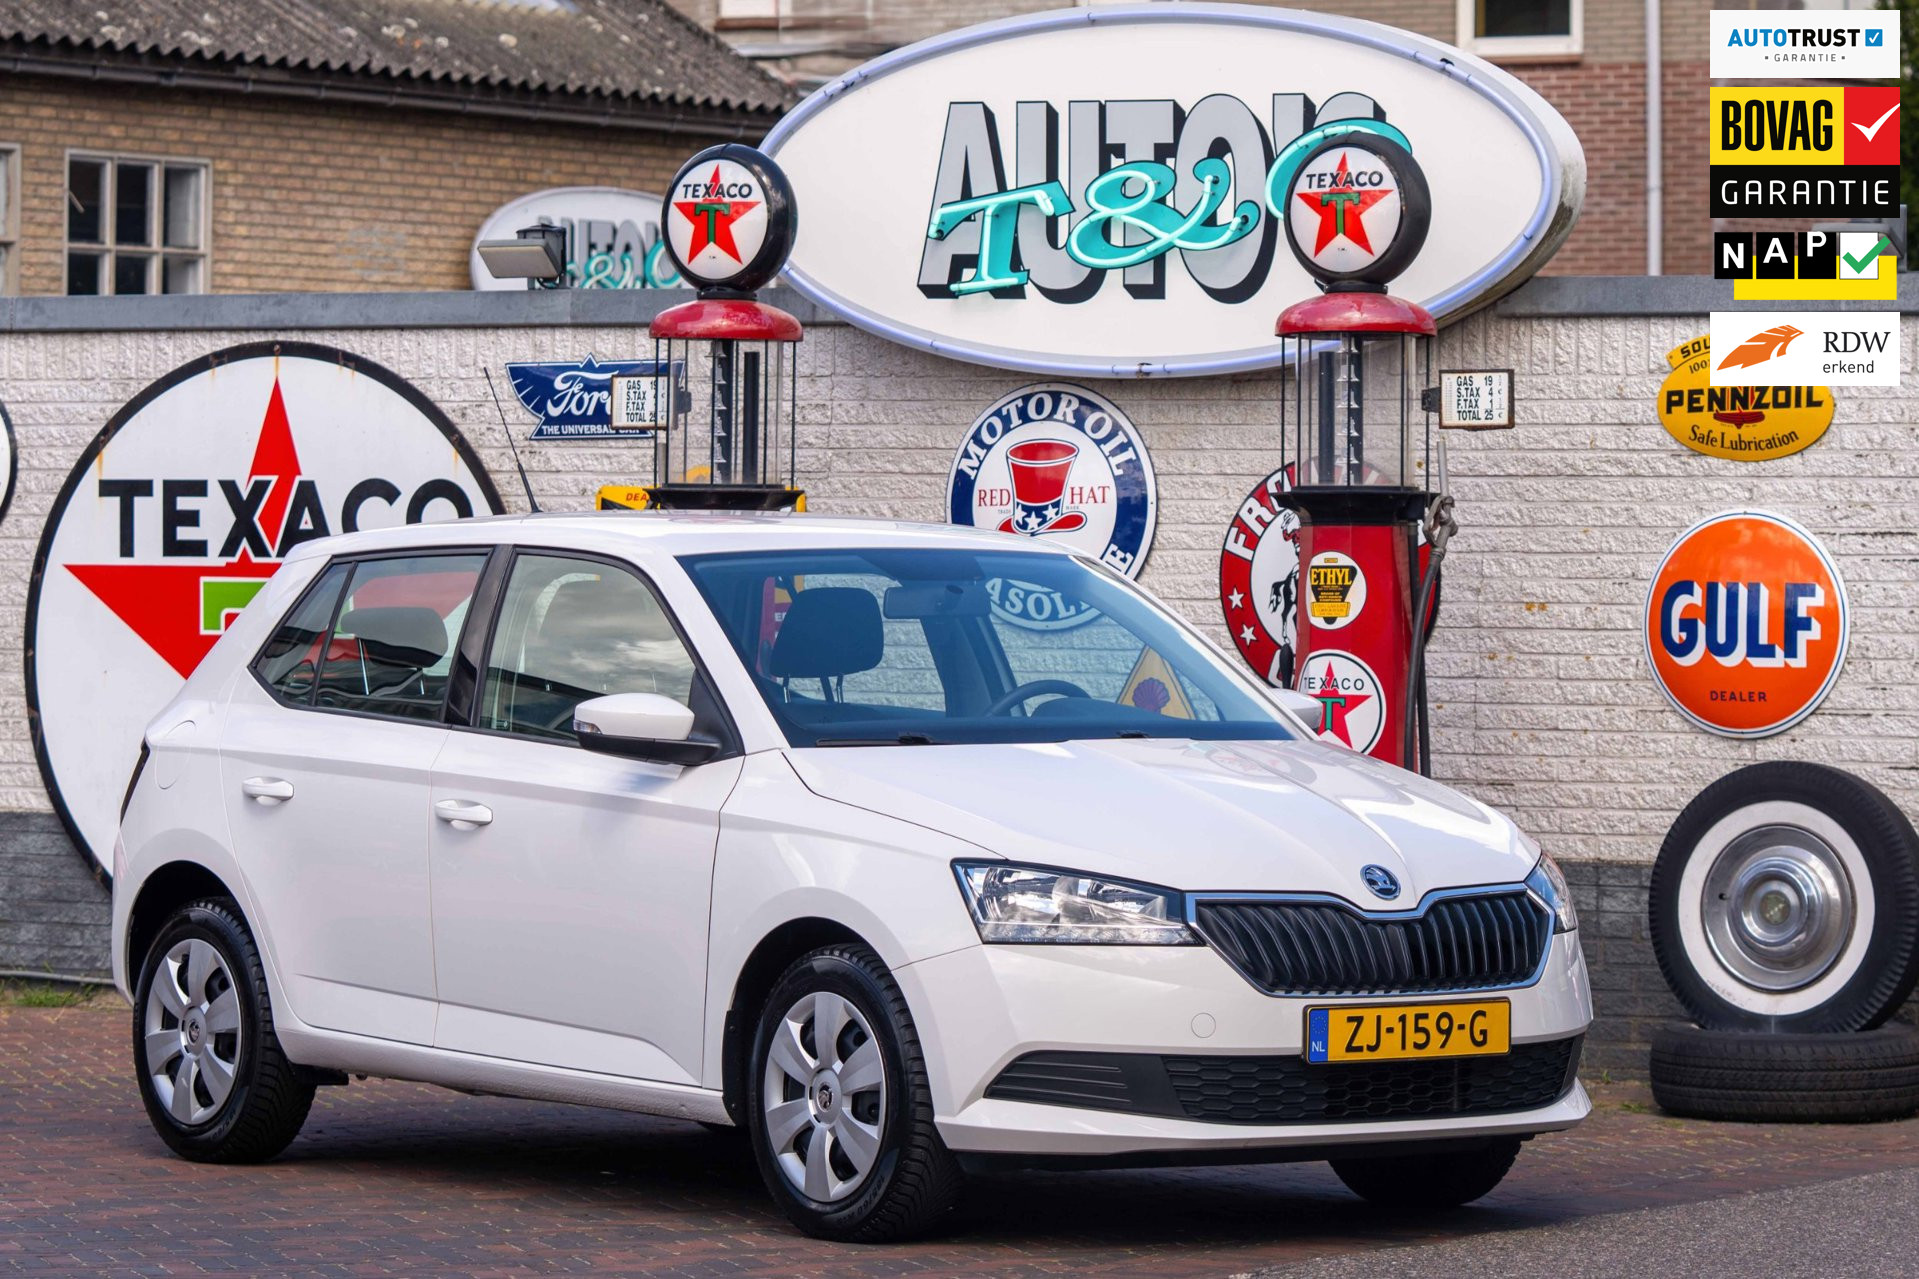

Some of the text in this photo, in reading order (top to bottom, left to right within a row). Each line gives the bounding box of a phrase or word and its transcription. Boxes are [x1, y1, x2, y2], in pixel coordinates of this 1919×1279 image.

[1306, 170, 1384, 189] TEXACO
[682, 183, 753, 199] TEXACO
[1321, 191, 1361, 236] T
[694, 203, 730, 243] T
[626, 380, 642, 391] GAS
[1456, 375, 1493, 387] GAS 19
[626, 391, 647, 401] S.TAX
[1456, 387, 1493, 398] S.TAX 4
[1665, 385, 1825, 415] PENNZOIL
[626, 401, 646, 412] F.TAX
[1456, 398, 1480, 409] F.TAX
[626, 412, 647, 423] TOTAL
[1456, 410, 1494, 421] TOTAL 25
[541, 425, 561, 435] THE
[561, 425, 616, 435] UNIVERSAL
[958, 393, 1137, 481] MOTOR OIL
[1688, 424, 1800, 452] Safe Lubrication
[977, 486, 1111, 507] RED HAT
[98, 478, 475, 558] TEXACO
[1311, 567, 1353, 586] ETHYL
[1660, 580, 1825, 668] GULF
[1303, 676, 1365, 691] TEXACO
[1710, 690, 1768, 703] DEALER
[1311, 1009, 1489, 1054] NL ZJ-159-G
